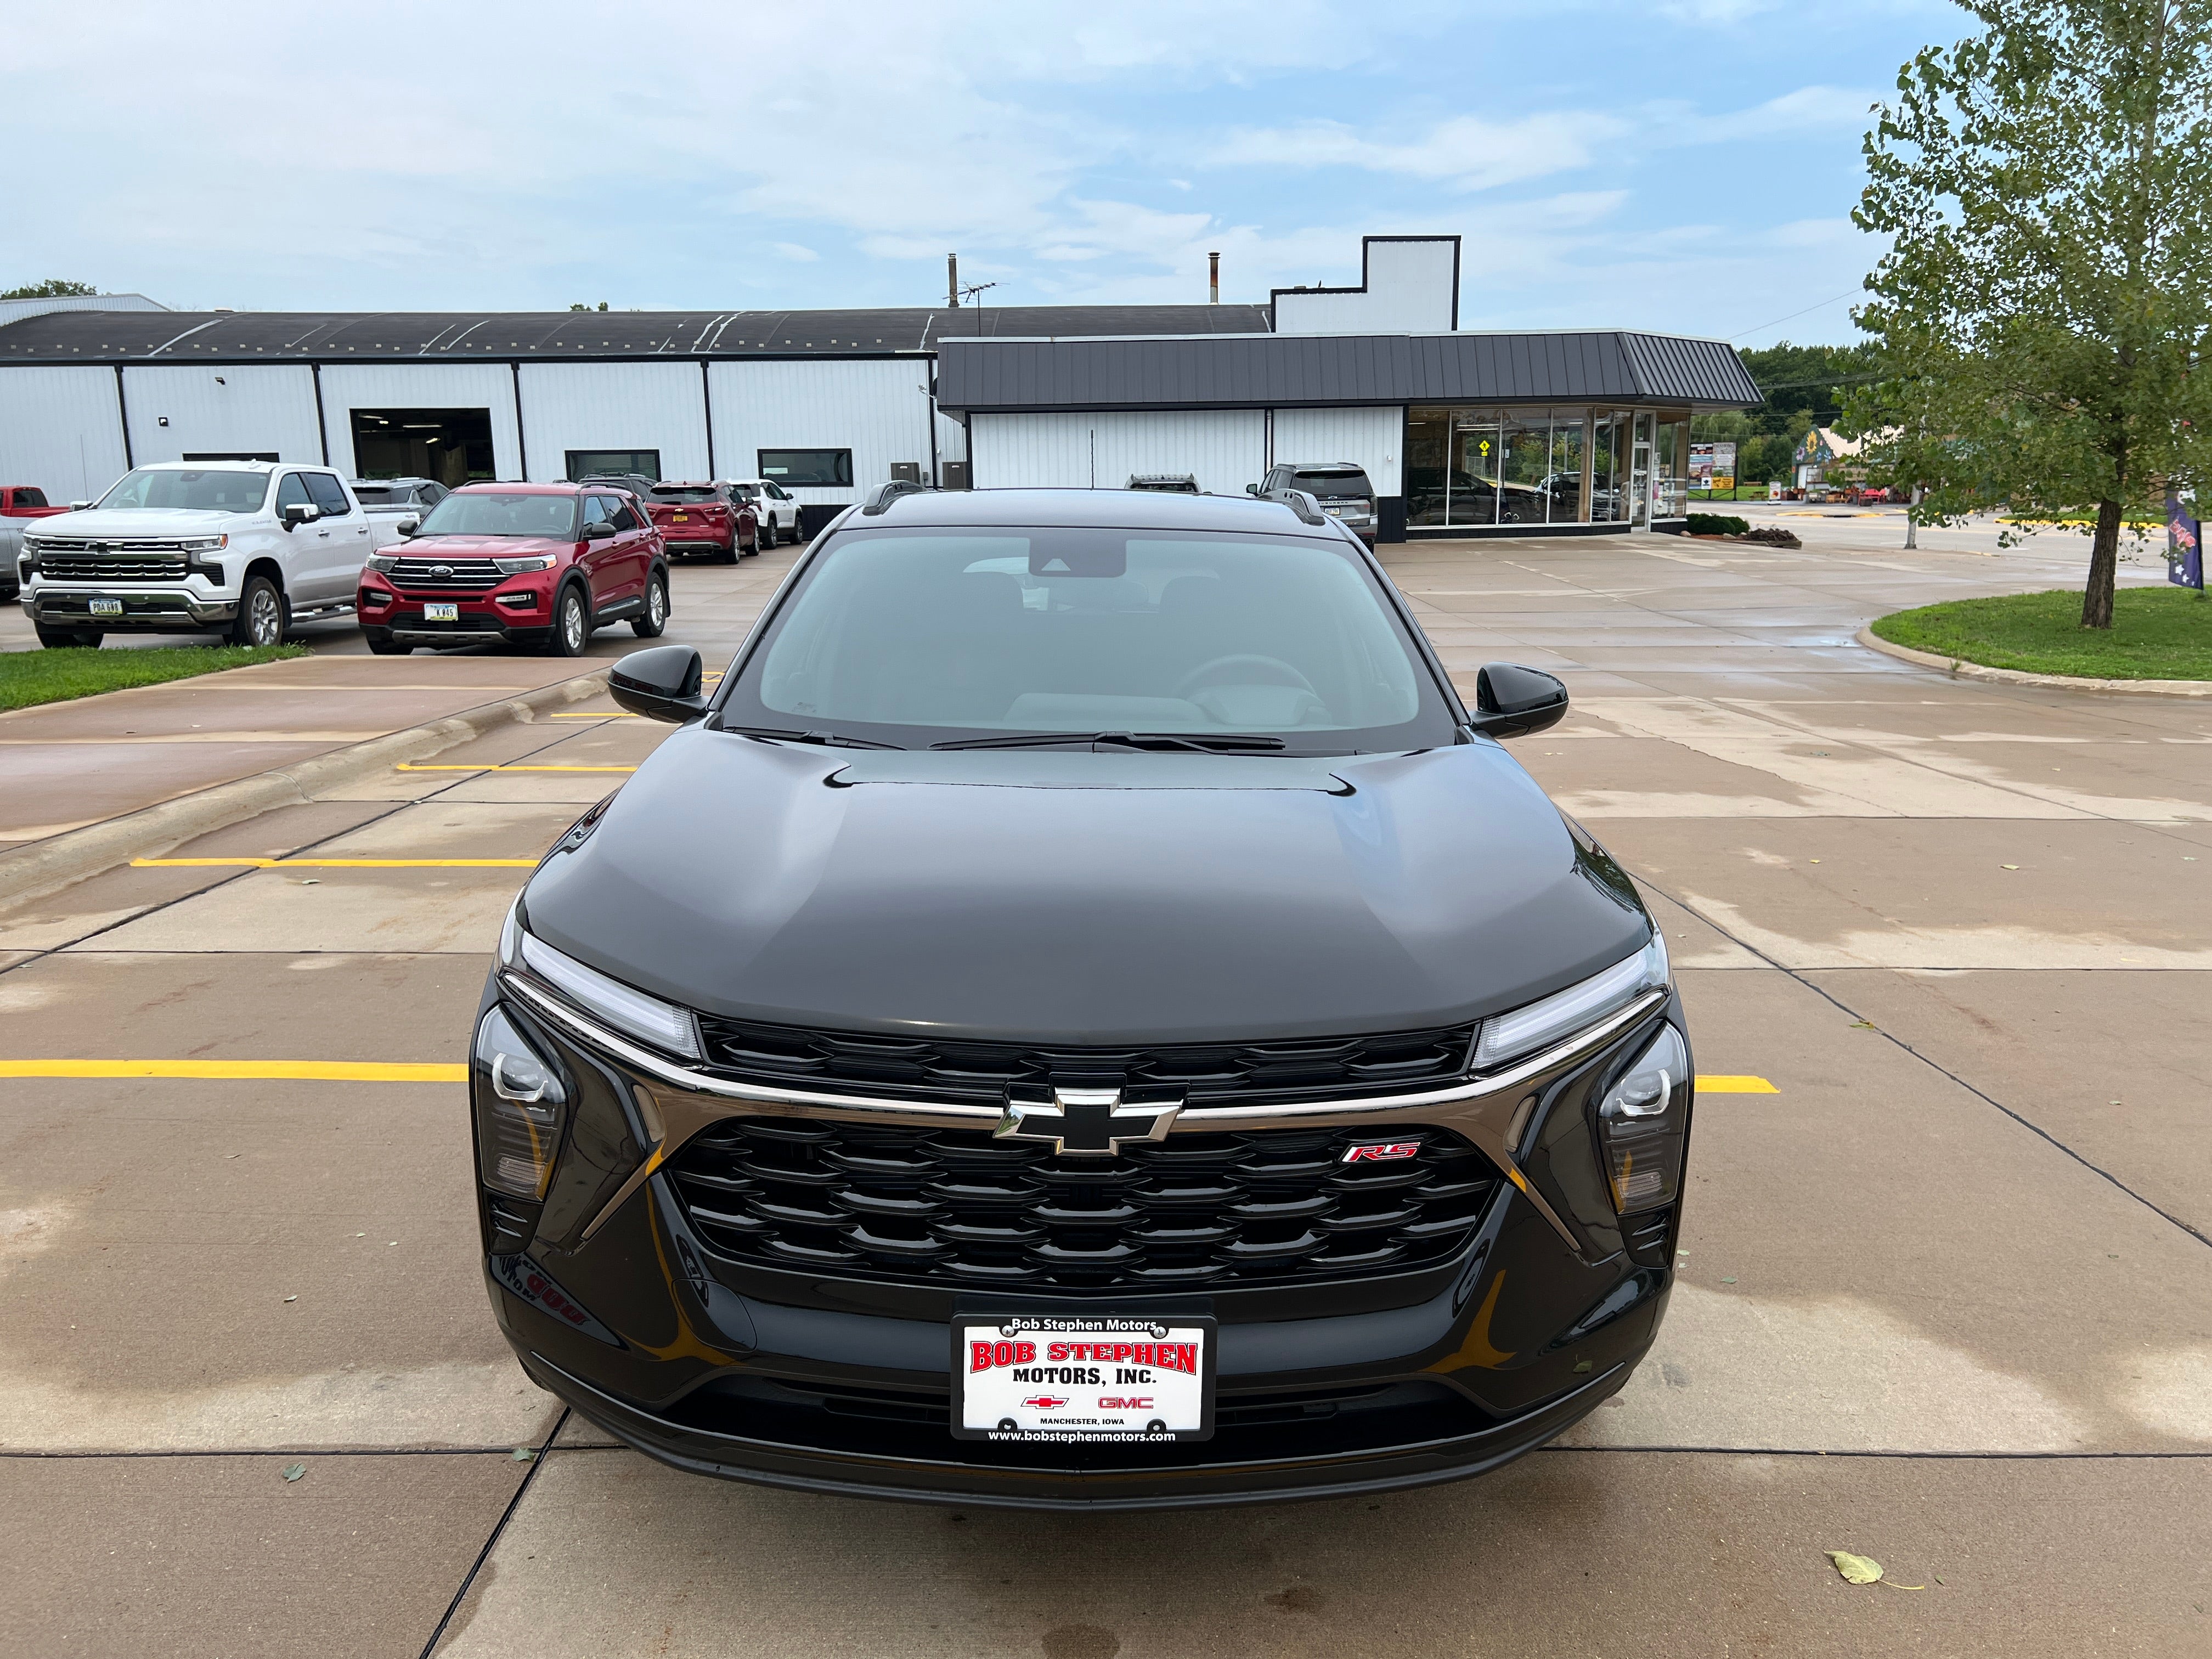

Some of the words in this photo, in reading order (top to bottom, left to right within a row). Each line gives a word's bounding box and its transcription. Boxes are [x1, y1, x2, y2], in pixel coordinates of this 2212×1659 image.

[1342, 1142, 1421, 1163] RS
[1012, 1318, 1040, 1330] Bob
[1043, 1320, 1103, 1332] Stephen
[1106, 1320, 1156, 1331] Motors
[970, 1341, 1036, 1373] BOB
[1048, 1342, 1197, 1376] STEPHEN
[1013, 1368, 1107, 1387] MOTORS,
[1116, 1368, 1156, 1384] INC.
[1098, 1396, 1154, 1409] GMC
[988, 1430, 1176, 1443] www.bobstephenmotors.com
